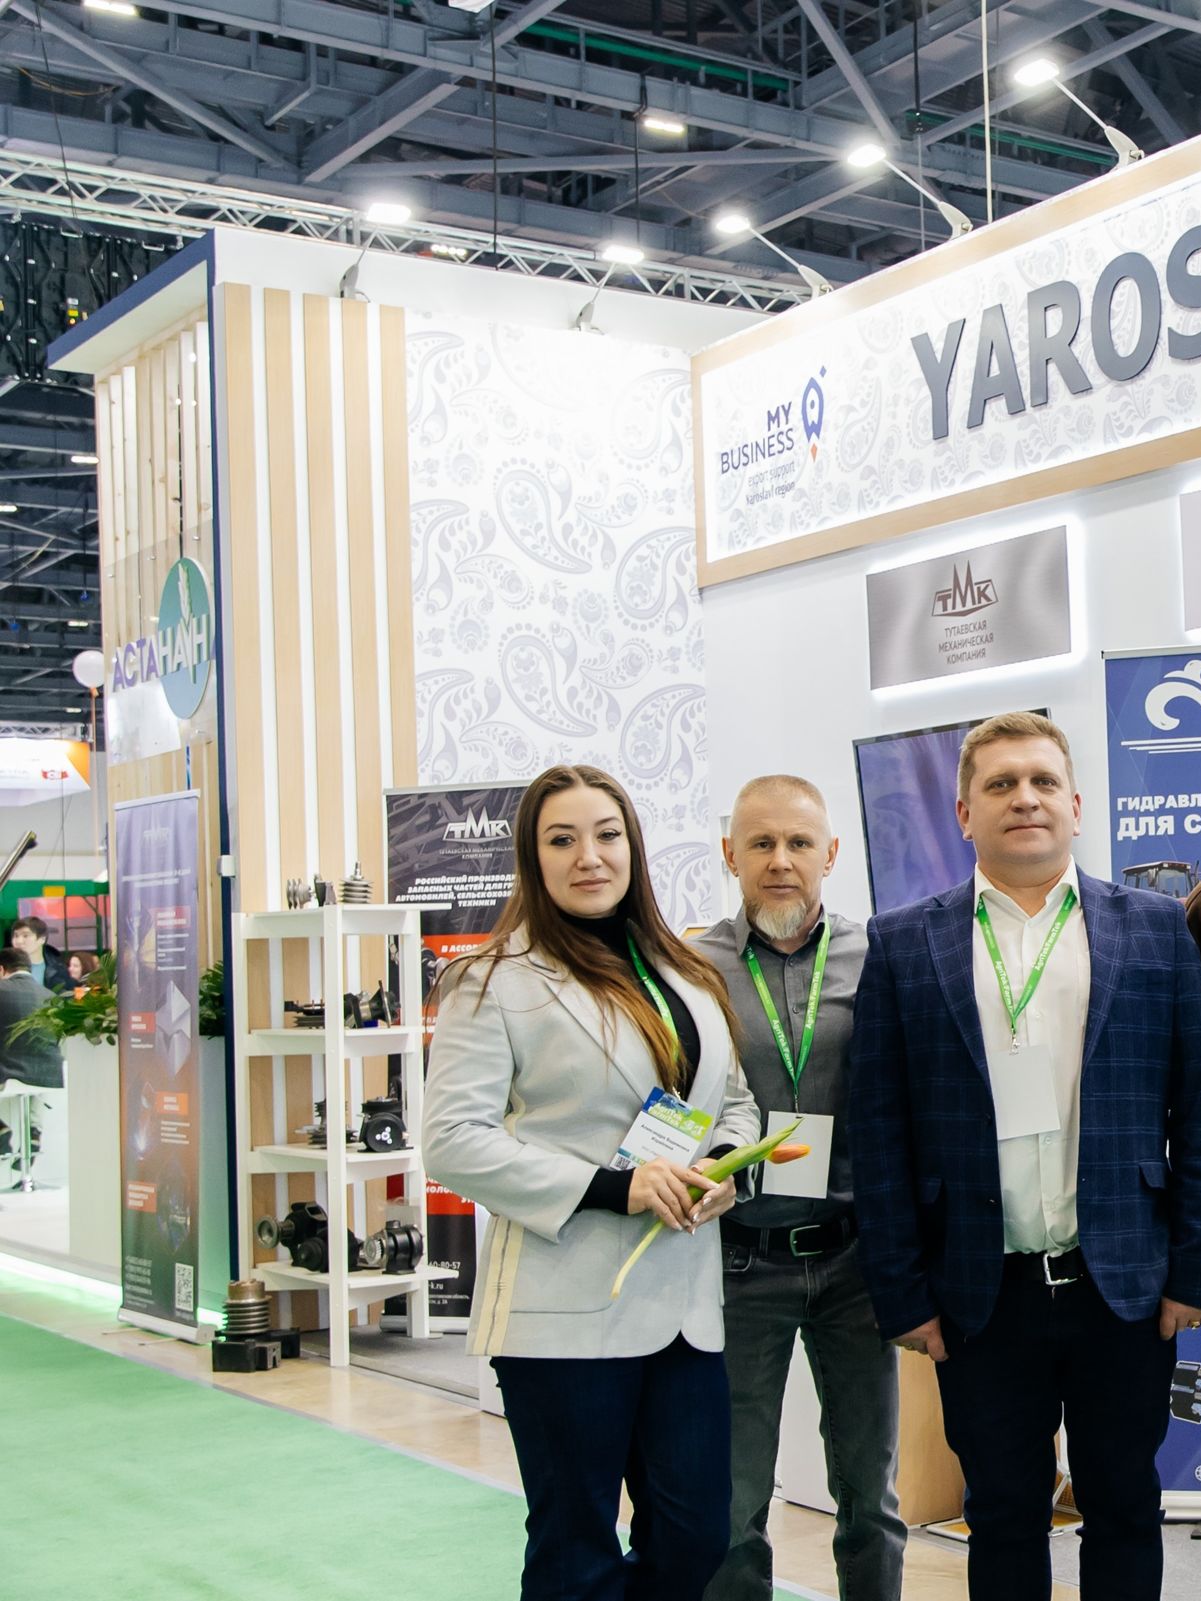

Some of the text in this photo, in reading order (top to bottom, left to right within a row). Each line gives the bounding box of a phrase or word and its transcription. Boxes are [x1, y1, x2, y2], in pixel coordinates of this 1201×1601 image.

[767, 401, 792, 432] MY
[720, 427, 794, 475] BUSINESS
[936, 560, 993, 613] ТМК
[945, 619, 987, 639] ТУТАЕВСКАЯ
[938, 633, 994, 653] МЕХАНИЧЕСКАЯ
[946, 648, 986, 665] КОМПАНИЯ
[449, 806, 506, 839] ТМК
[1117, 815, 1175, 841] ДЛЯ
[408, 884, 453, 894] ЗАПАСНЫХ
[453, 882, 484, 891] ЧАСТЕЙ
[484, 882, 503, 890] ДЛЯ
[415, 875, 467, 885] РОССИЙСКИЙ
[395, 892, 456, 902] АВТОМОБИЛЕЙ,
[457, 899, 497, 907] ТЕХНИКИ
